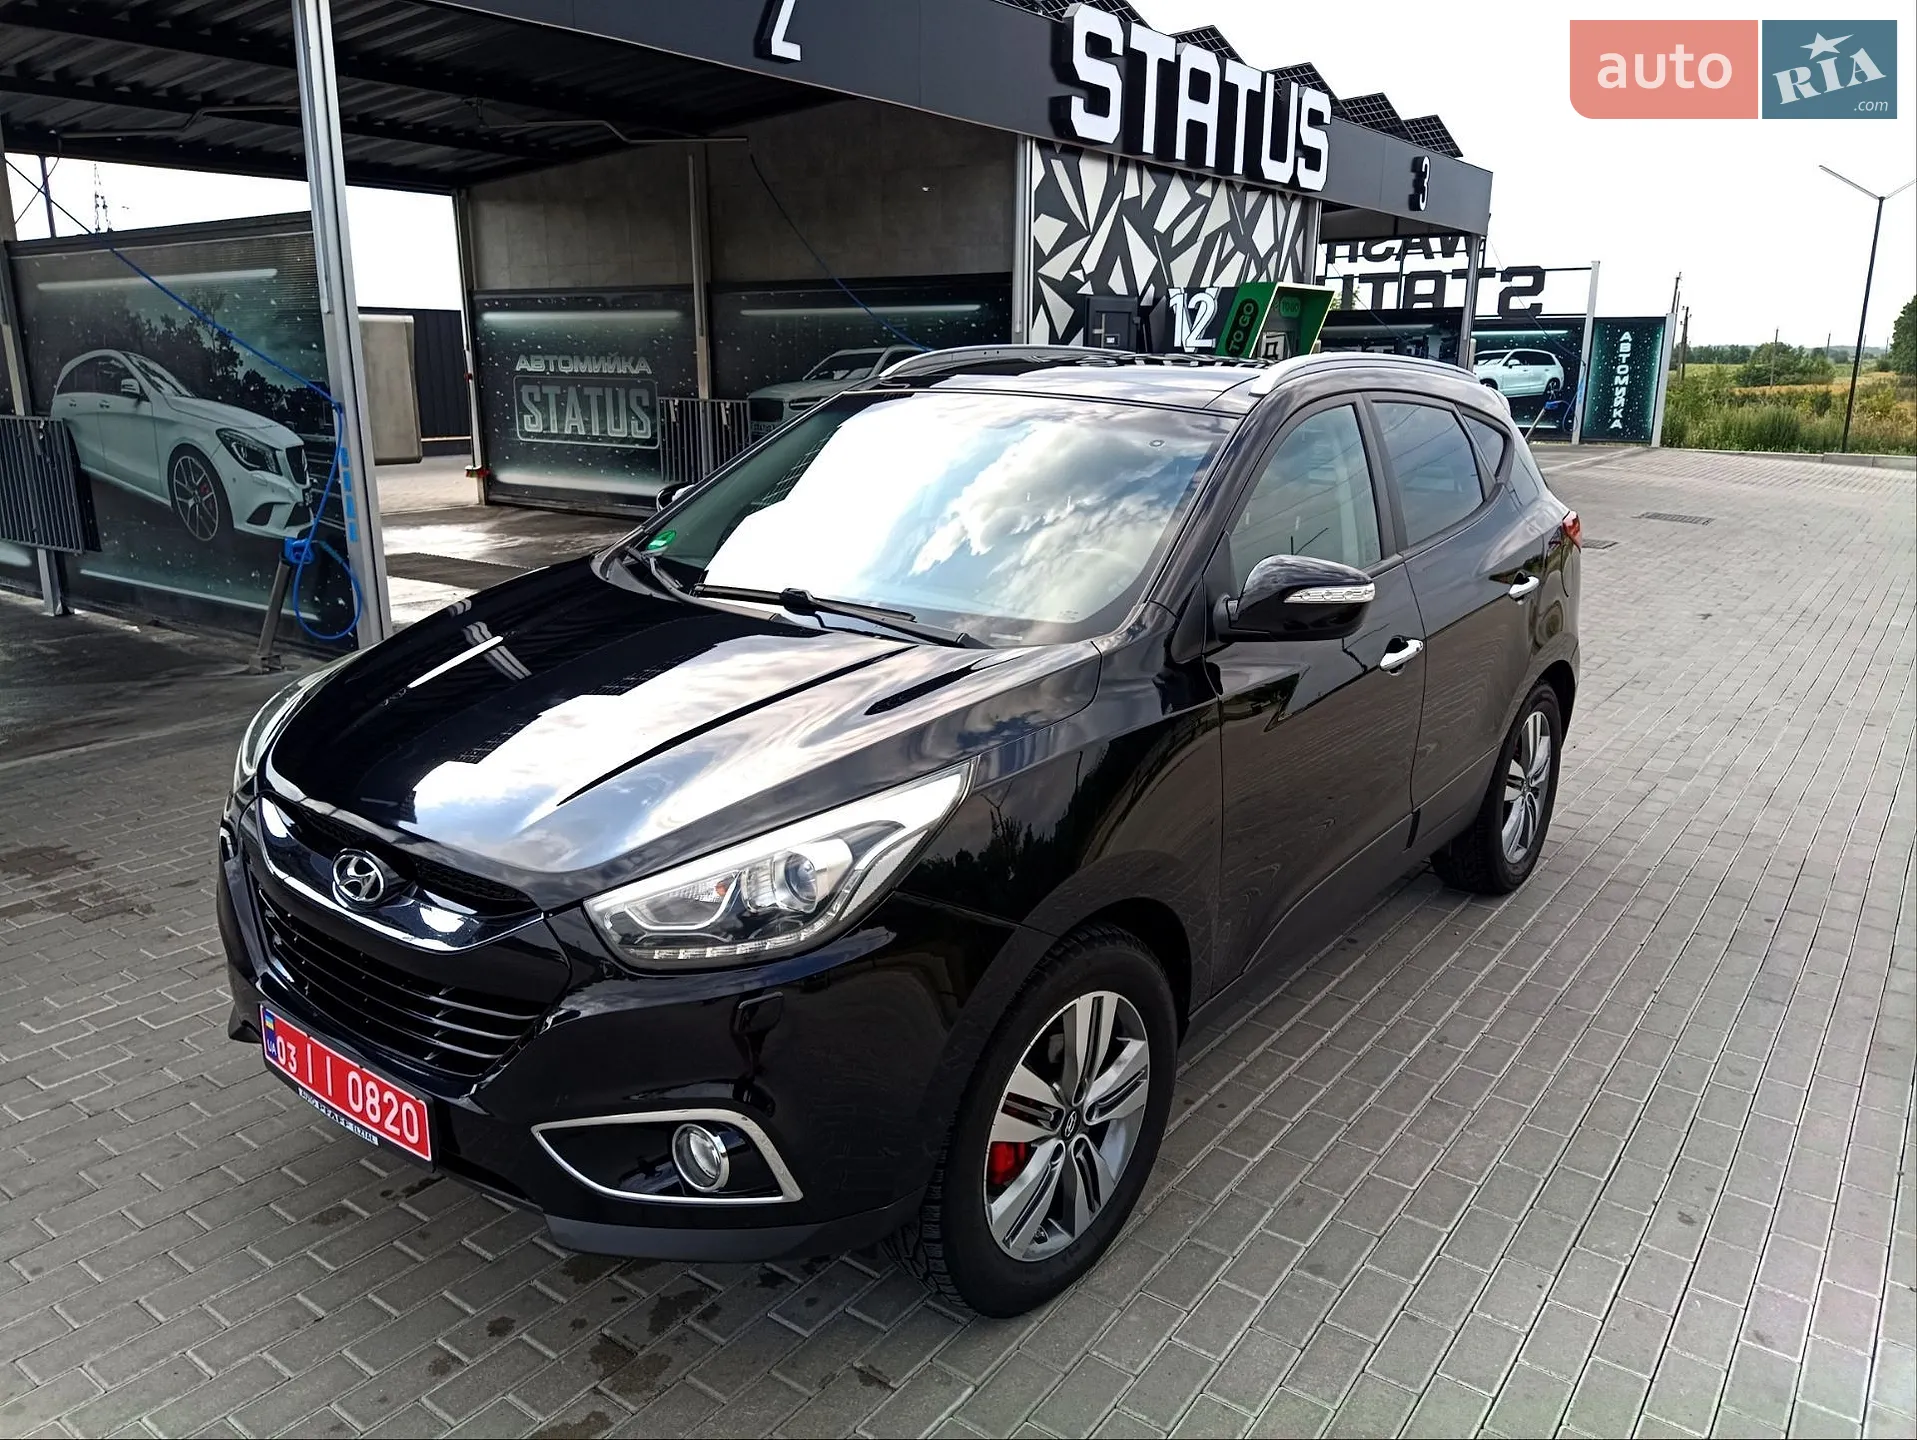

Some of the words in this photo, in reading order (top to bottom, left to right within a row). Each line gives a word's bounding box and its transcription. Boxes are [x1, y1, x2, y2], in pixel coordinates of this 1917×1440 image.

[1070, 3, 1332, 192] STATUS
[1419, 156, 1430, 211] 3
[1228, 330, 1244, 352] TO
[1239, 302, 1255, 327] GO
[516, 352, 652, 374] АВТОМИЙКА
[1610, 331, 1632, 428] АВТОМИЙКА
[520, 384, 652, 439] STATUS
[266, 1040, 277, 1056] UA
[276, 1035, 297, 1074] 03
[347, 1070, 420, 1144] 0820
